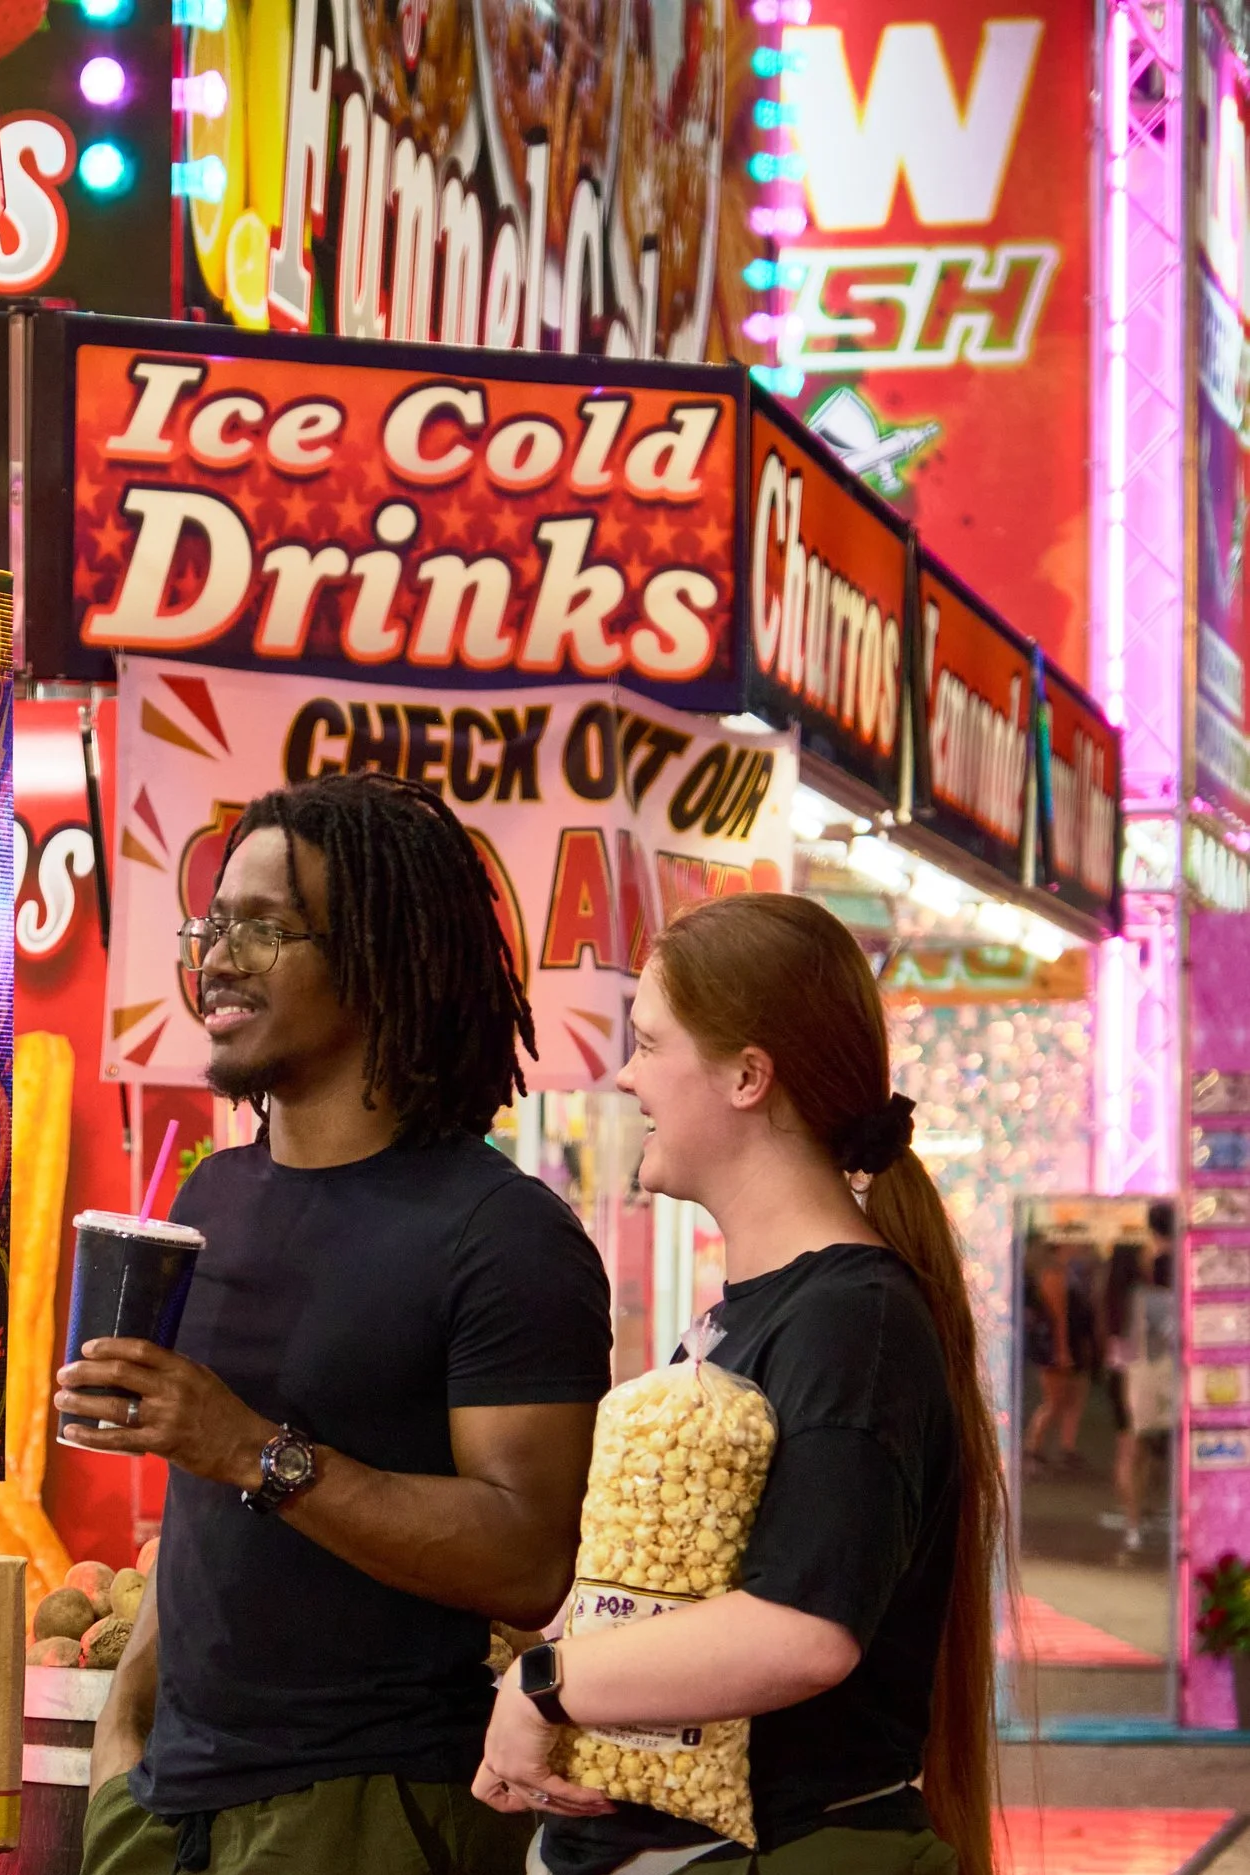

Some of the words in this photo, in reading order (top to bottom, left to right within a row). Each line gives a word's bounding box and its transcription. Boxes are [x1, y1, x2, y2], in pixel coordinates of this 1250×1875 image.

[105, 361, 346, 470] Ice
[382, 384, 720, 498] Cold
[81, 487, 719, 680] Drinks
[753, 448, 903, 760] Churros
[283, 697, 552, 804] CHECK
[667, 742, 776, 840] OUR
[594, 1595, 637, 1618] POP
